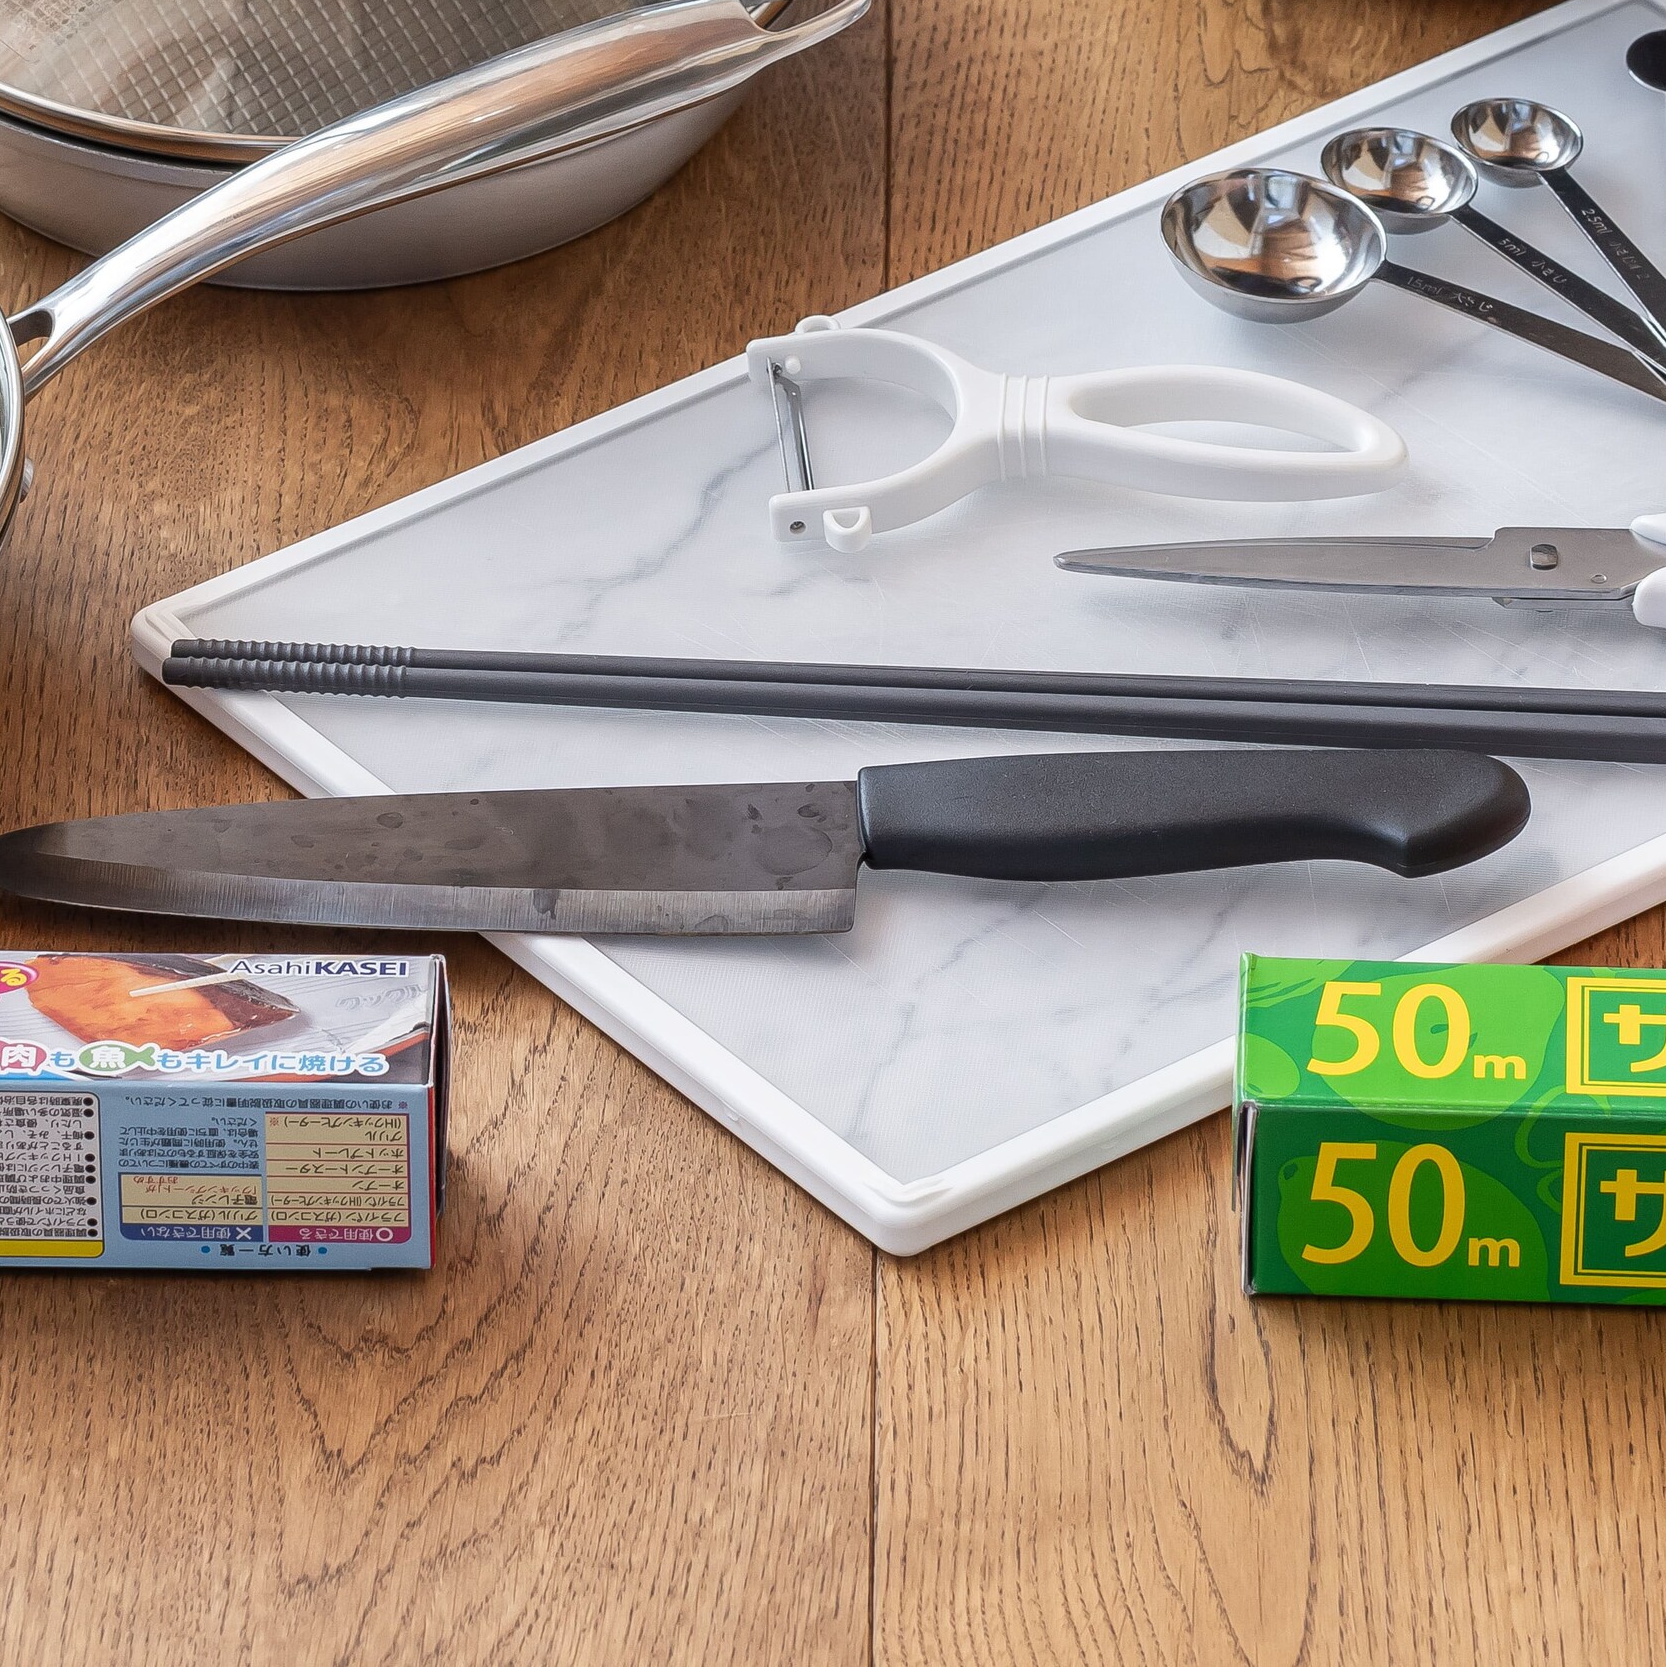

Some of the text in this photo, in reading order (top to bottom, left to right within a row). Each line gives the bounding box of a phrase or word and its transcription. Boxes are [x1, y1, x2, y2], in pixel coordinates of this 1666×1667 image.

[365, 1131, 403, 1142] グリル
[312, 1148, 404, 1159] ホットプレート
[285, 1164, 404, 1175] オーブントースター
[352, 1180, 404, 1191] オーブン
[192, 1194, 258, 1206] 電子レンジ
[141, 1226, 231, 1240] 使用できない
[299, 1228, 373, 1240] 使用できる
